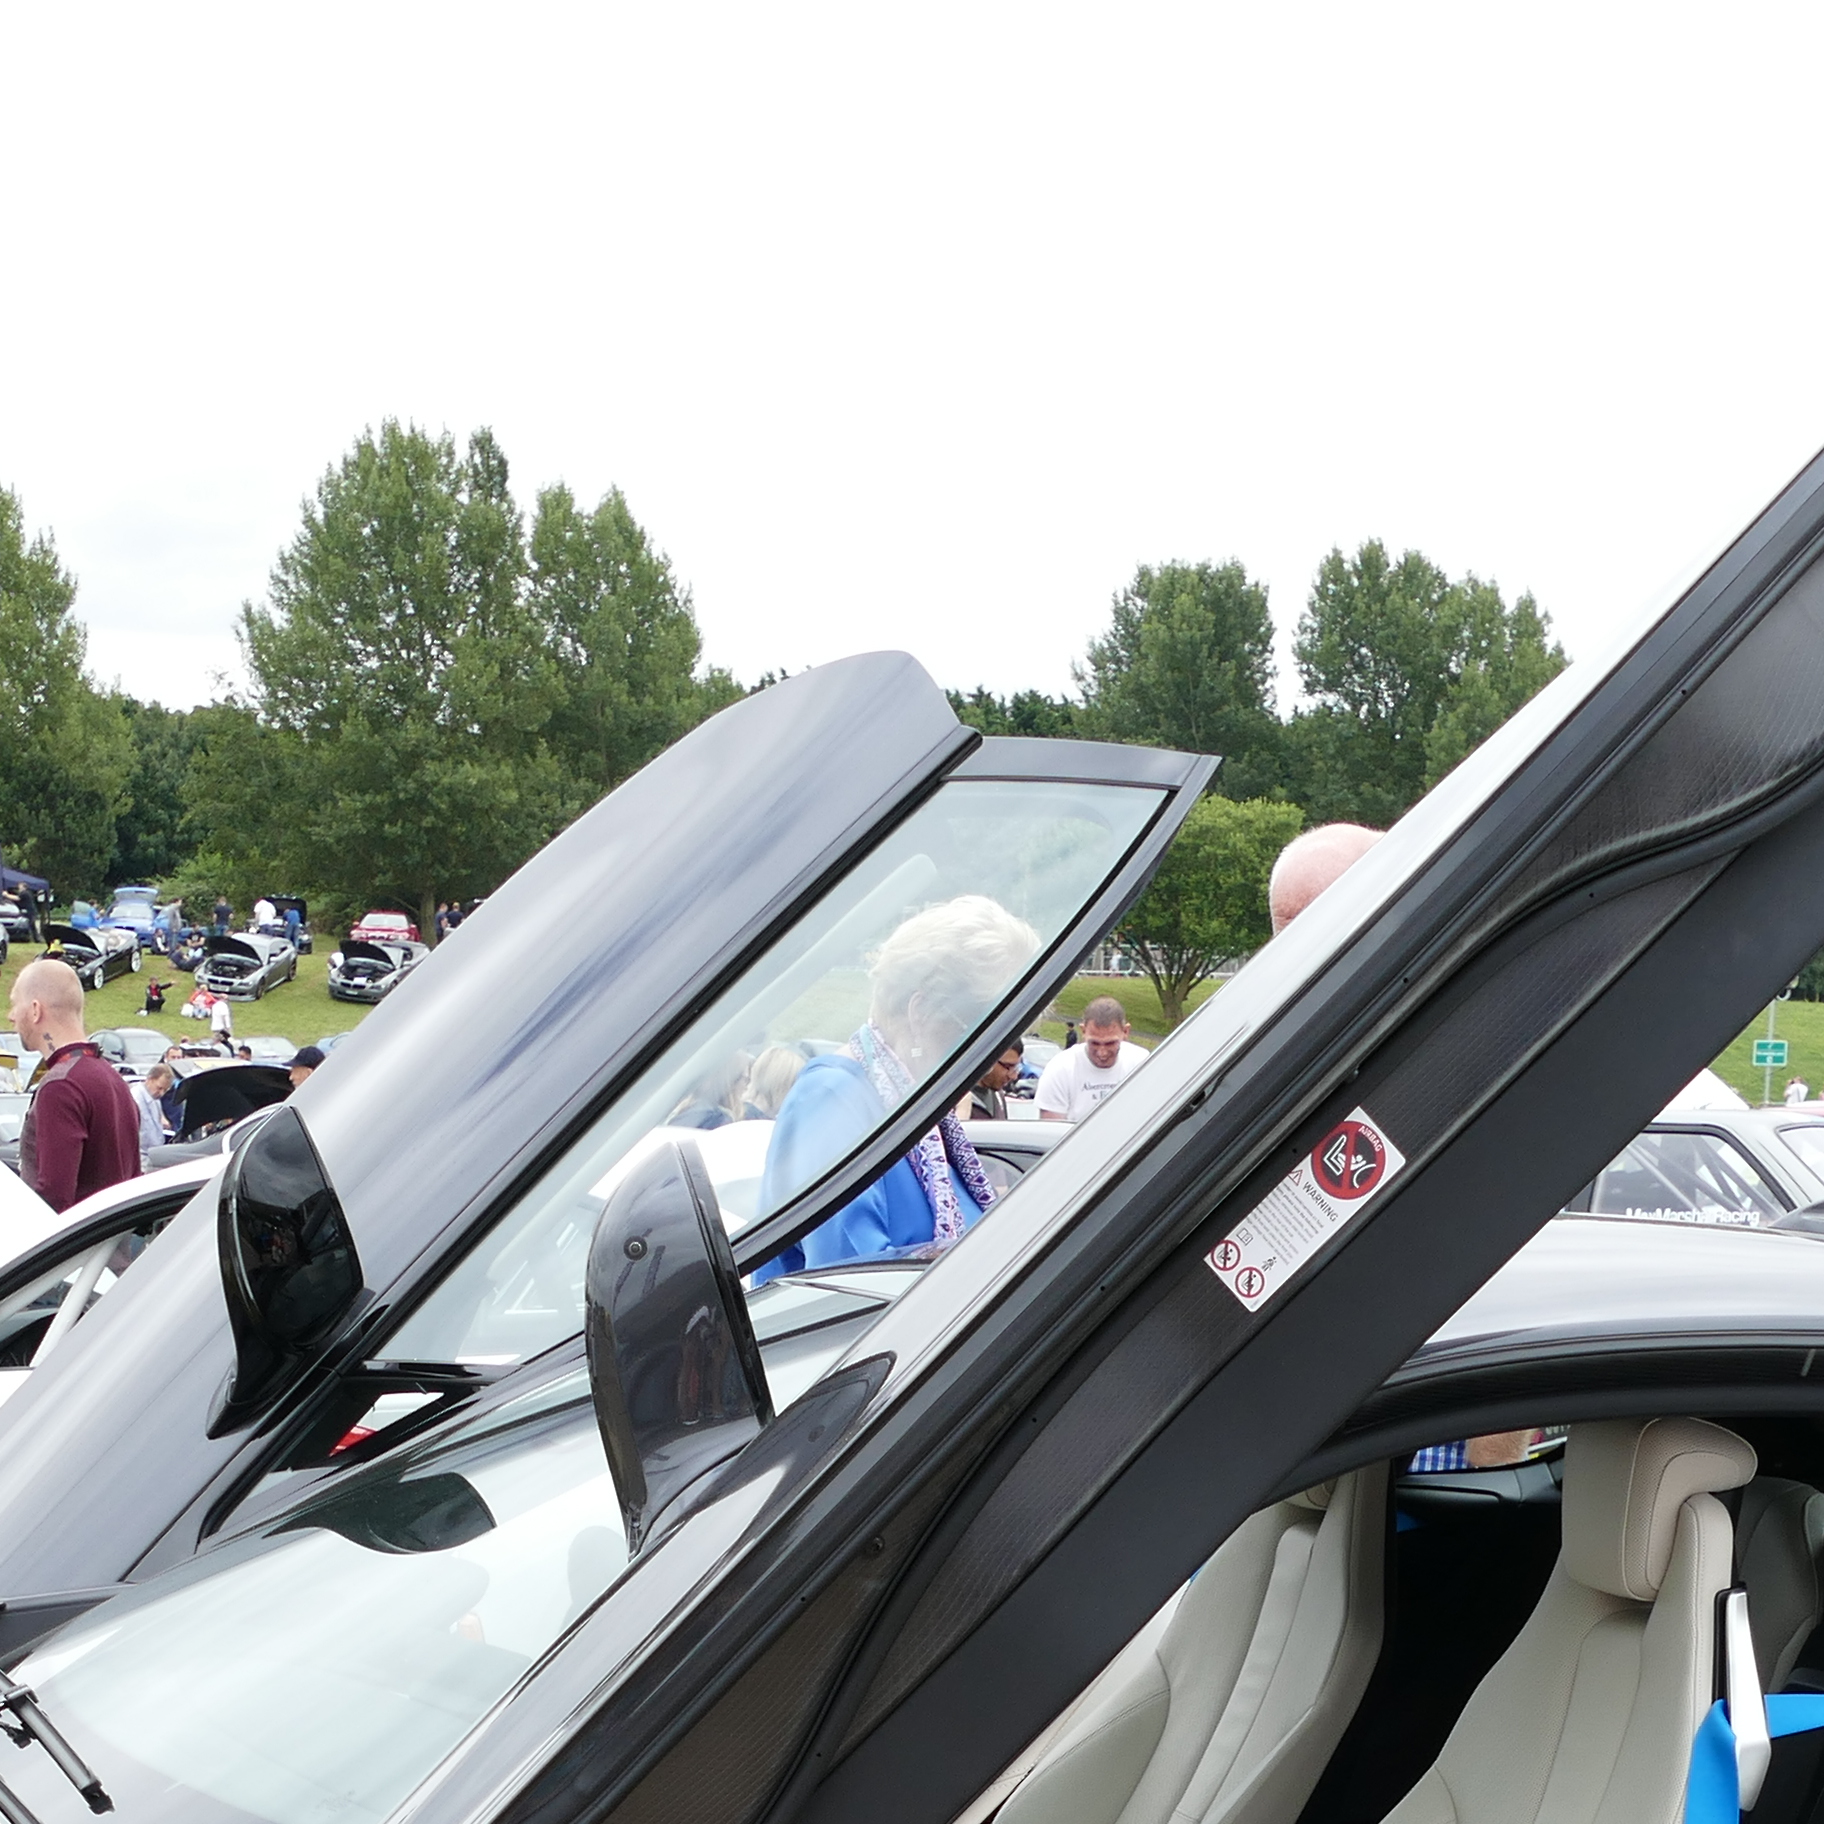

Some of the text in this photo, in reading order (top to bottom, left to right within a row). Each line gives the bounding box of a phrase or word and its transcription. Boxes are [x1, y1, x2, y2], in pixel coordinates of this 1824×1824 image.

[1358, 1125, 1383, 1152] AIRBAG
[1302, 1181, 1339, 1223] WARNING
[1715, 1210, 1760, 1227] Racing
